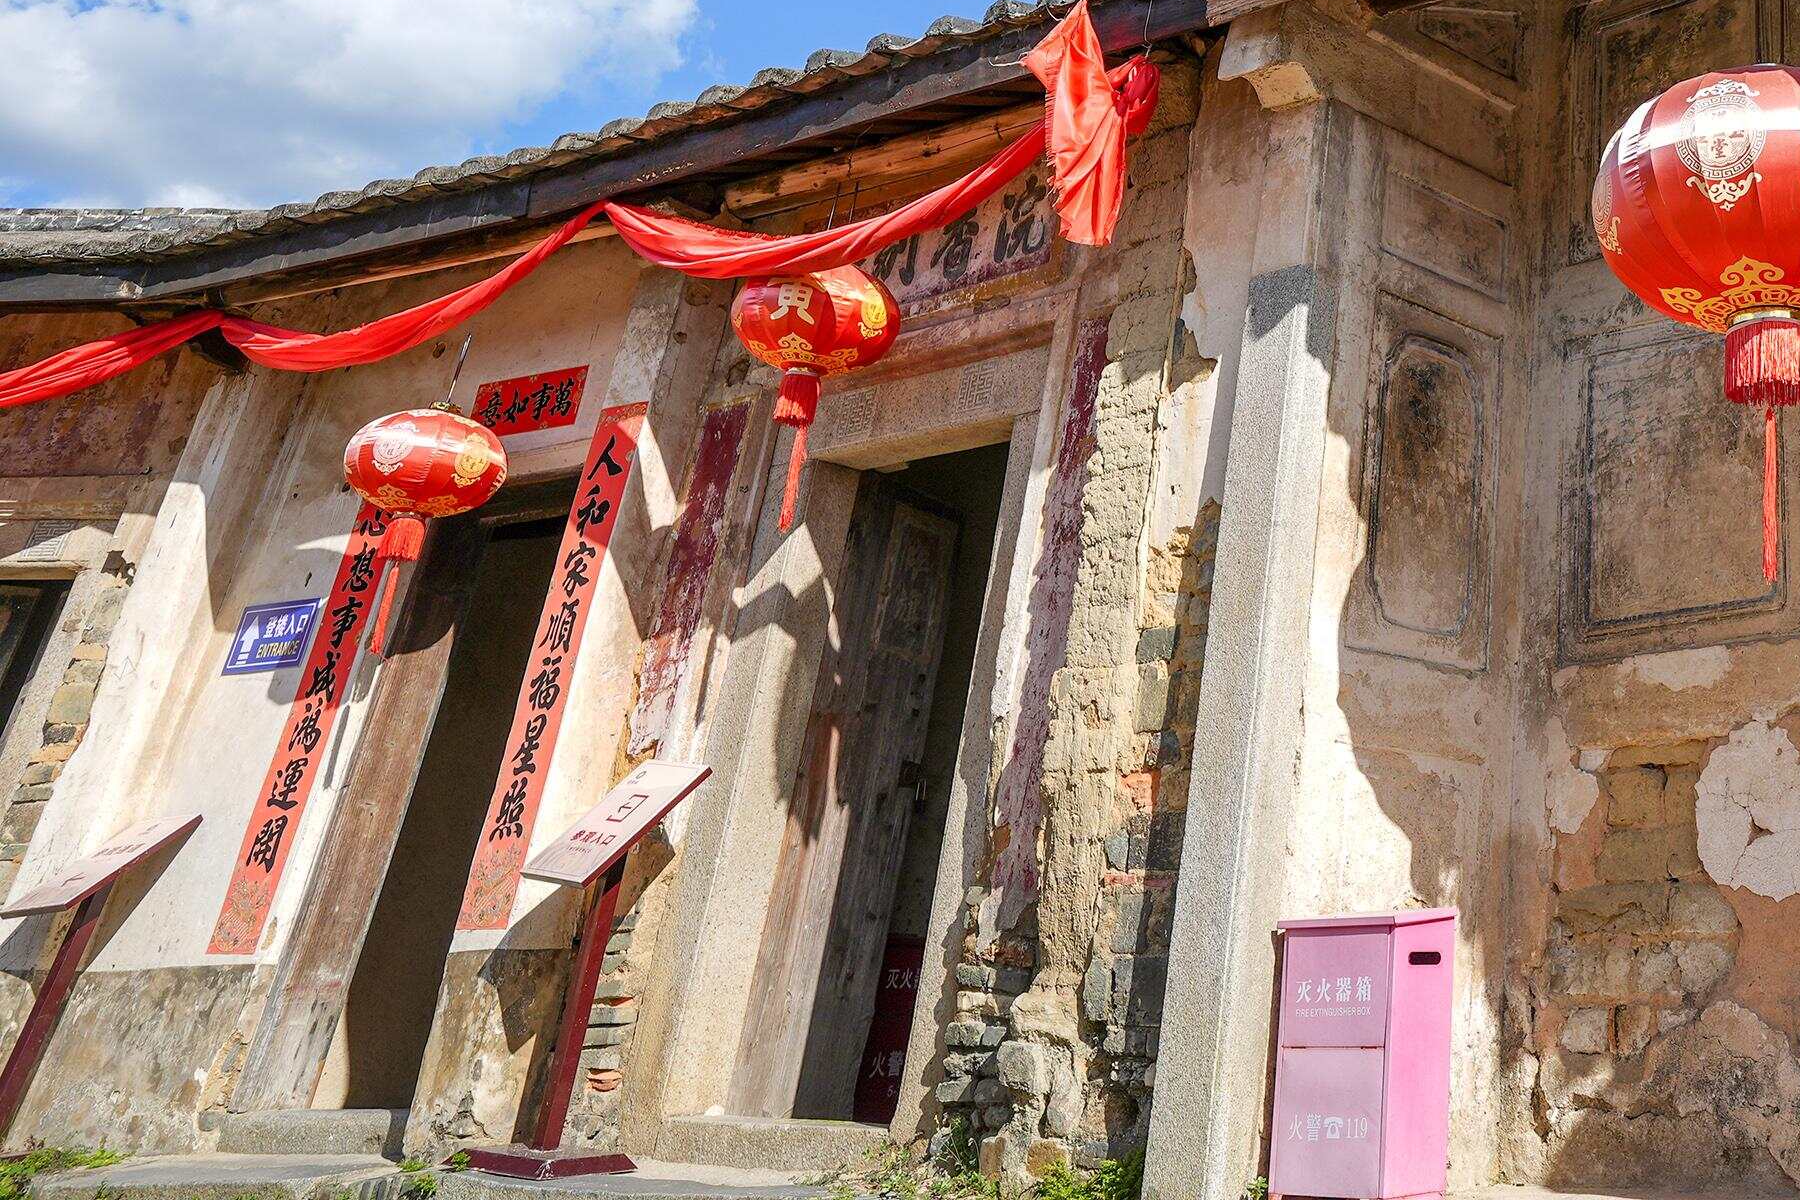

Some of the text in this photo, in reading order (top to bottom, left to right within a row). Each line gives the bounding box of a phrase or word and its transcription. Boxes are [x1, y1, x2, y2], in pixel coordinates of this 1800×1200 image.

[256, 640, 300, 659] ENTRANCE
[1295, 976, 1372, 1003] 灭火器箱
[1288, 1112, 1368, 1141] 火警 119
